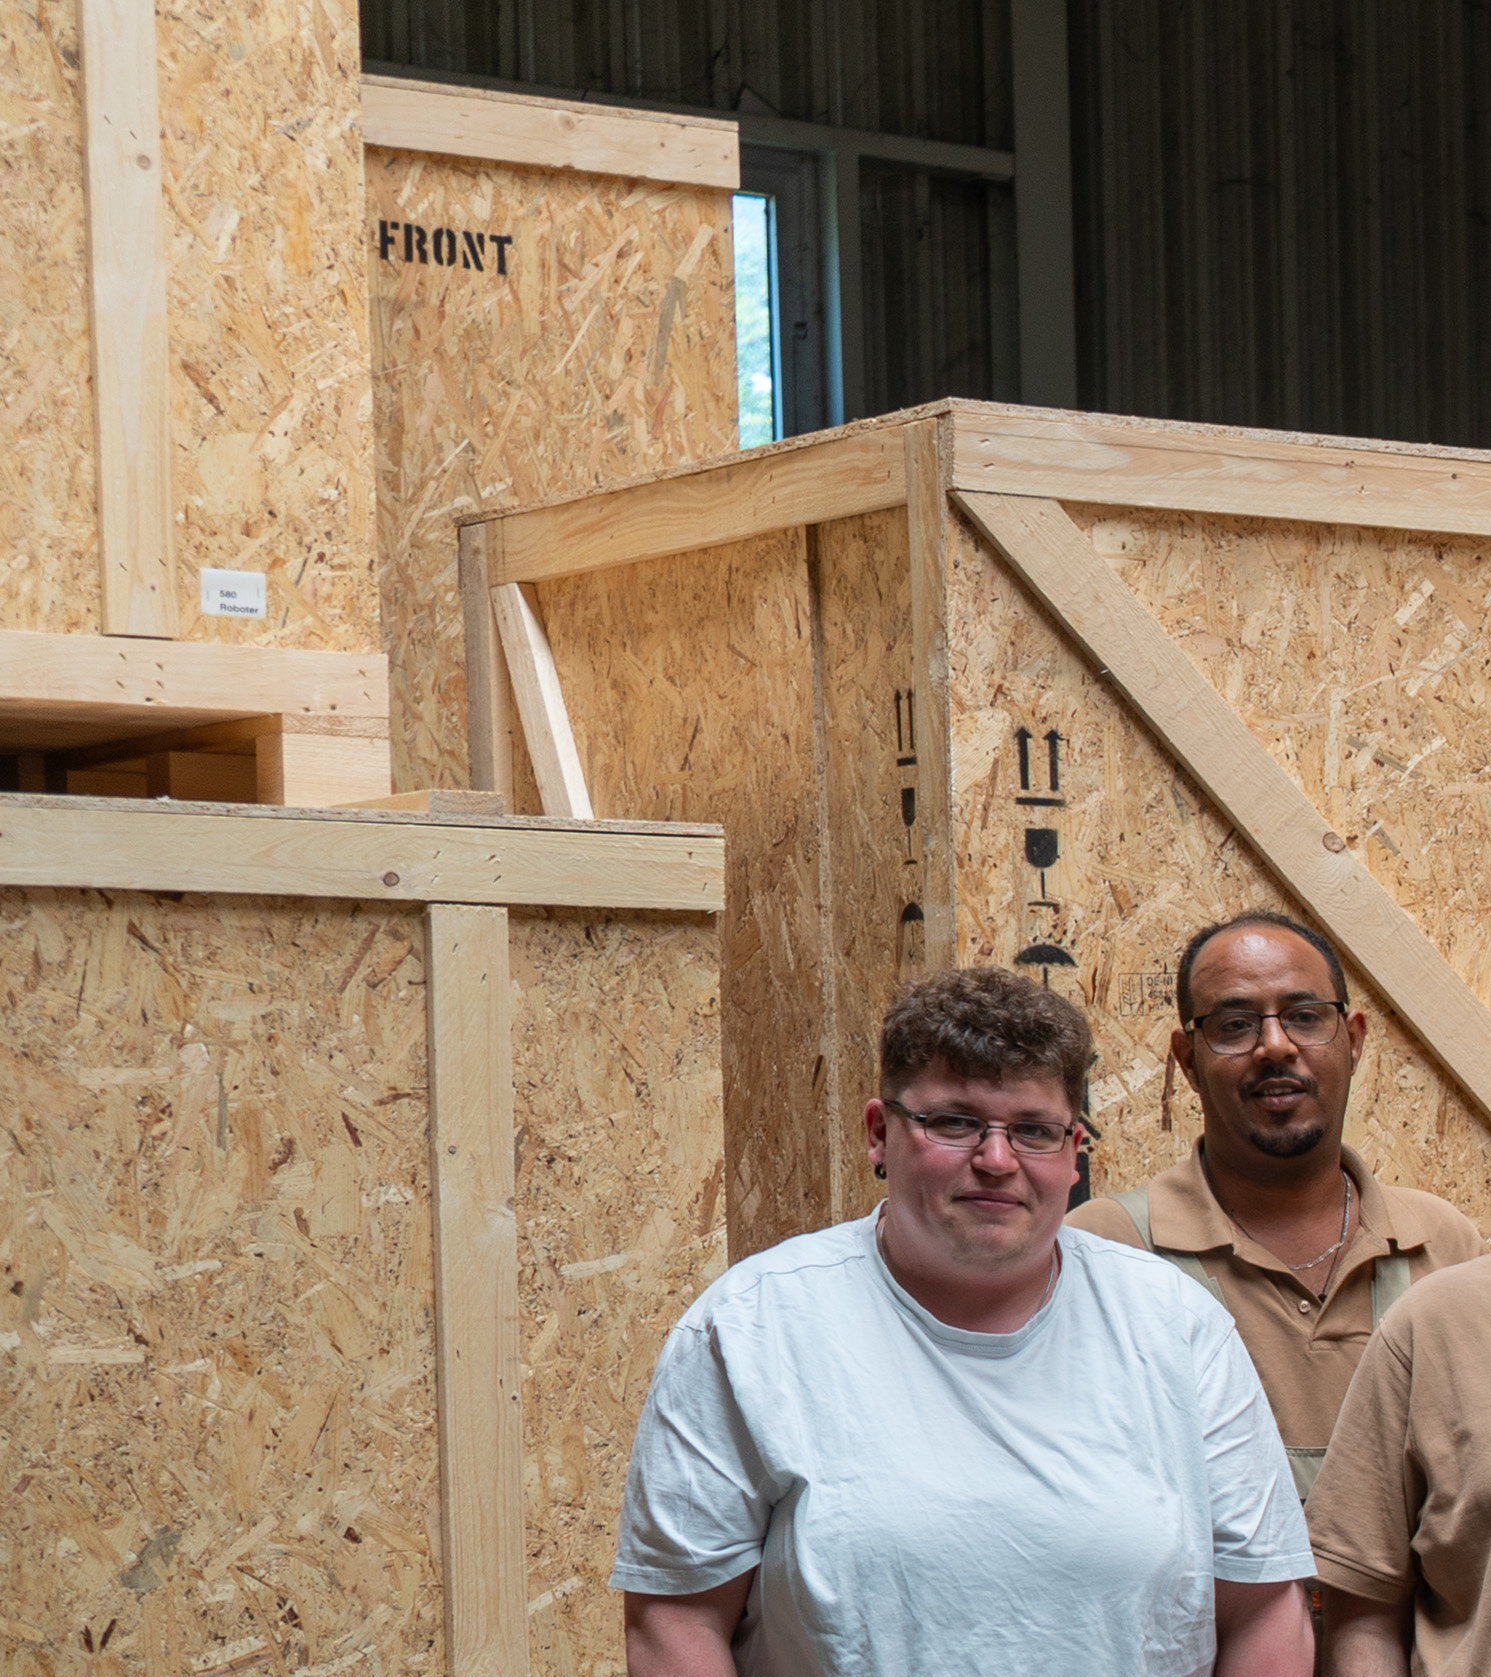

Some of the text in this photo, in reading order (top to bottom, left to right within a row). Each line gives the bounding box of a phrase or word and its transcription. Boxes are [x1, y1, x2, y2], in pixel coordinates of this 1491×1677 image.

[379, 220, 512, 275] FRONT
[219, 590, 237, 599] 580
[219, 603, 259, 614] Roboter
